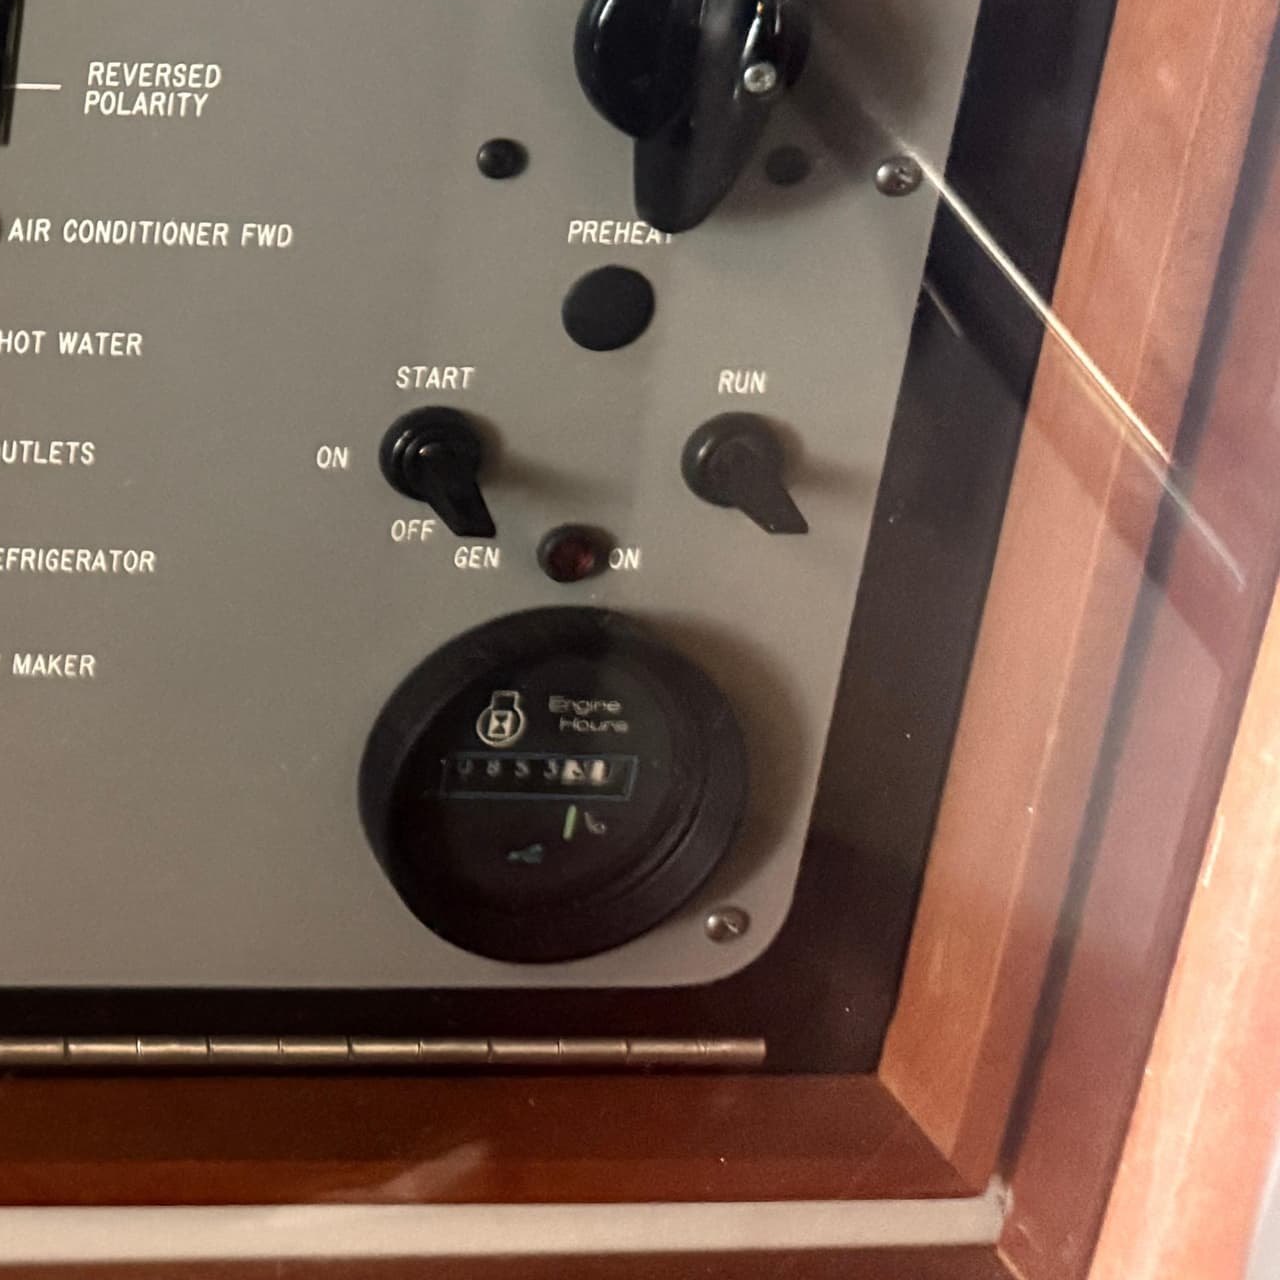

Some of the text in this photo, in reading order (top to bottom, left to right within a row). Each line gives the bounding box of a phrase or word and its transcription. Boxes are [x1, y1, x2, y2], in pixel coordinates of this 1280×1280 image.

[88, 62, 222, 89] REVERSED
[83, 91, 209, 117] POLARITY
[8, 219, 293, 247] AIR CONDITIONER FWD
[59, 332, 143, 356] WATER
[396, 366, 474, 390] START
[718, 371, 767, 394] RUN
[317, 447, 349, 469] ON
[391, 520, 434, 542] OFF
[454, 547, 640, 570] GEN ON
[13, 653, 96, 677] MAKER
[549, 696, 621, 715] Engine
[559, 717, 628, 733] Hours
